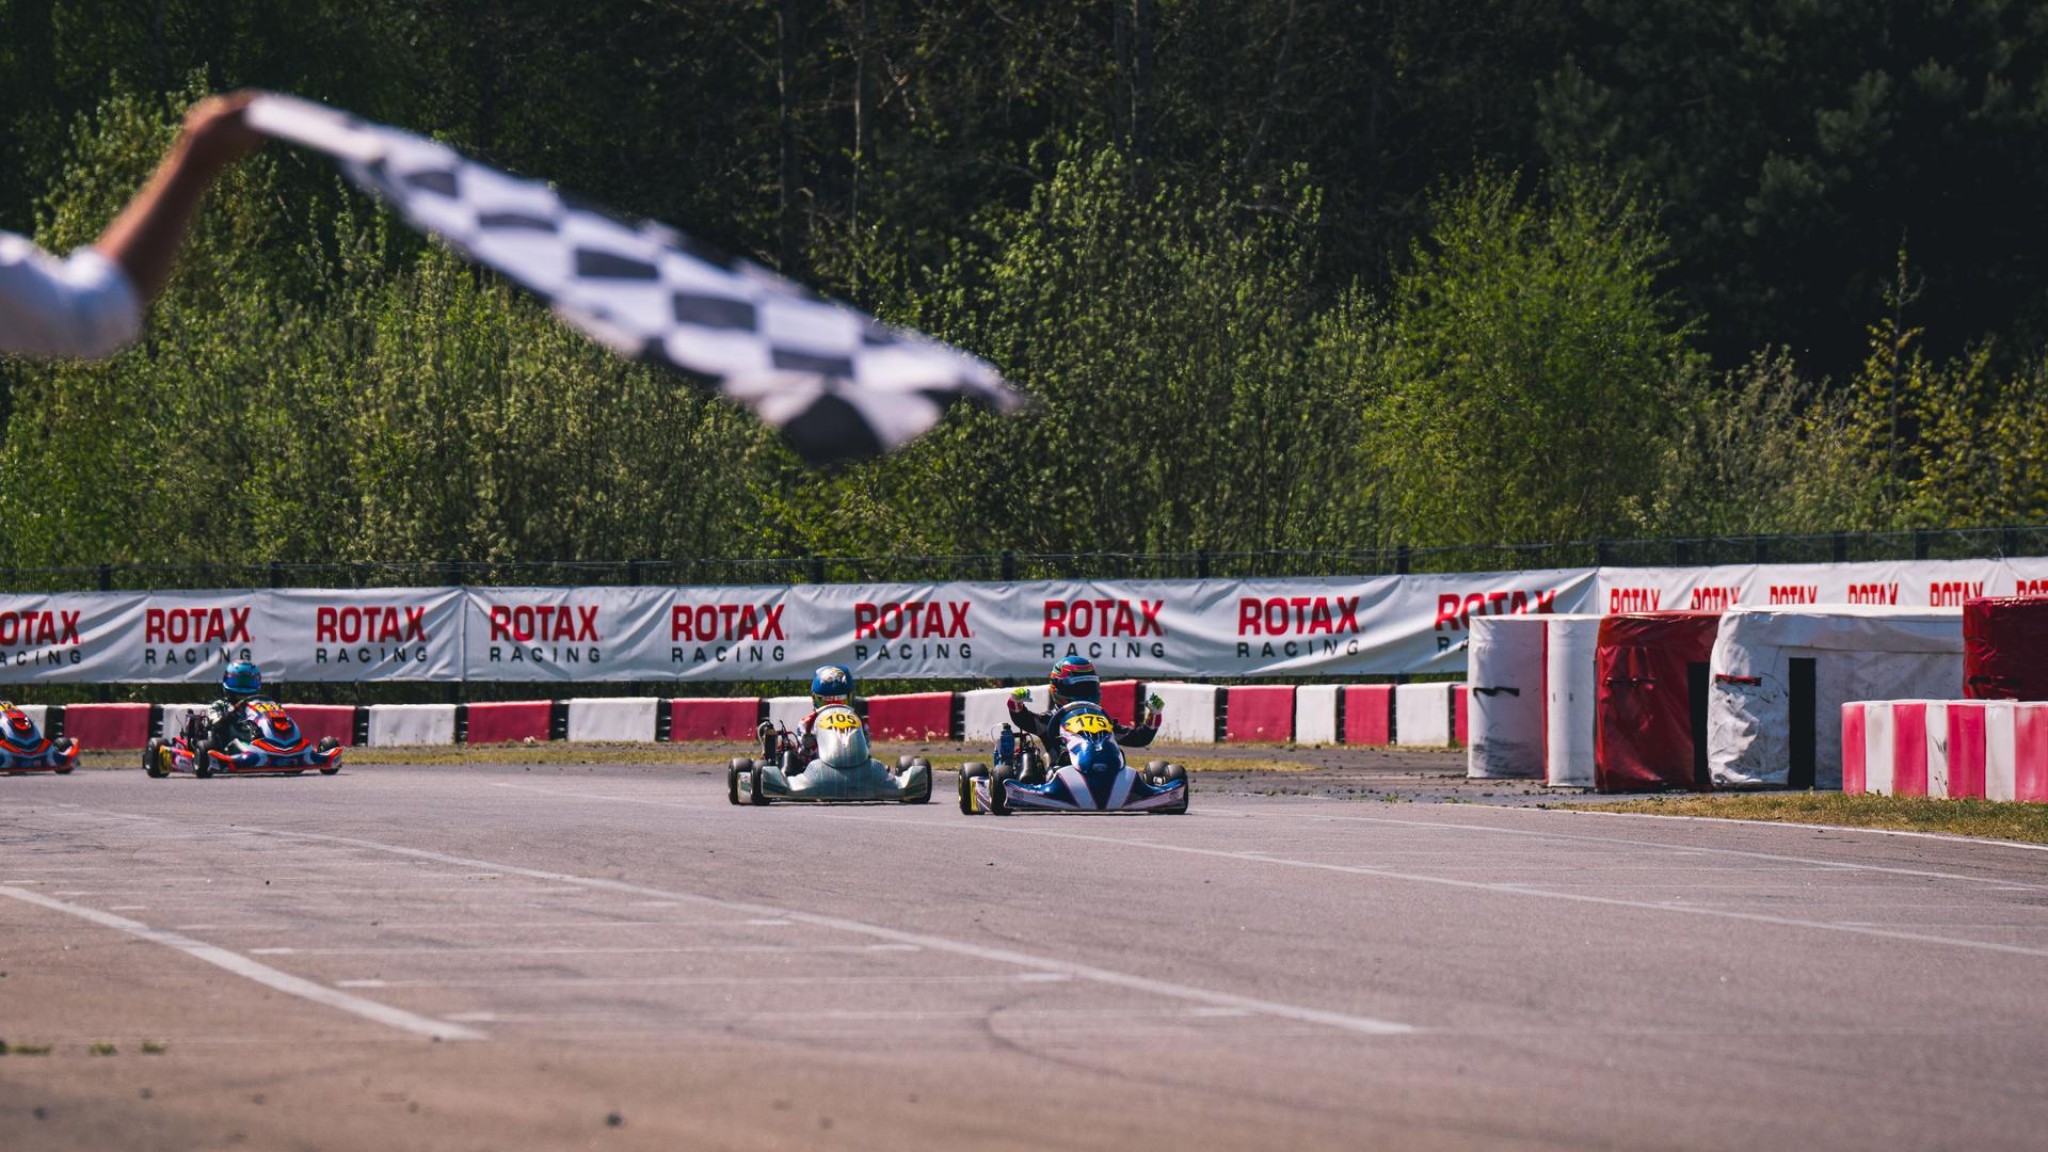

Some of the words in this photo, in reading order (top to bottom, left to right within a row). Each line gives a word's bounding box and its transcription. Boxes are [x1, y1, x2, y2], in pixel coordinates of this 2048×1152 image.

[317, 606, 426, 643] ROTAX
[489, 605, 598, 642] ROTAX
[672, 604, 784, 641] ROTAX
[854, 601, 971, 640] ROTAX
[1042, 599, 1164, 638] ROTAX
[1238, 595, 1360, 636] ROTAX
[0, 610, 81, 645] OTAX
[146, 607, 251, 644] ROTAX
[0, 648, 82, 667] ACING
[145, 647, 251, 665] RACING
[316, 646, 427, 664] RACING
[489, 646, 600, 663] RACING
[671, 645, 784, 663] RACING
[855, 643, 972, 661] RACING
[1042, 642, 1165, 659] RACING
[1237, 638, 1359, 658] RACING
[826, 713, 857, 725] 105
[1076, 715, 1107, 729] 175
